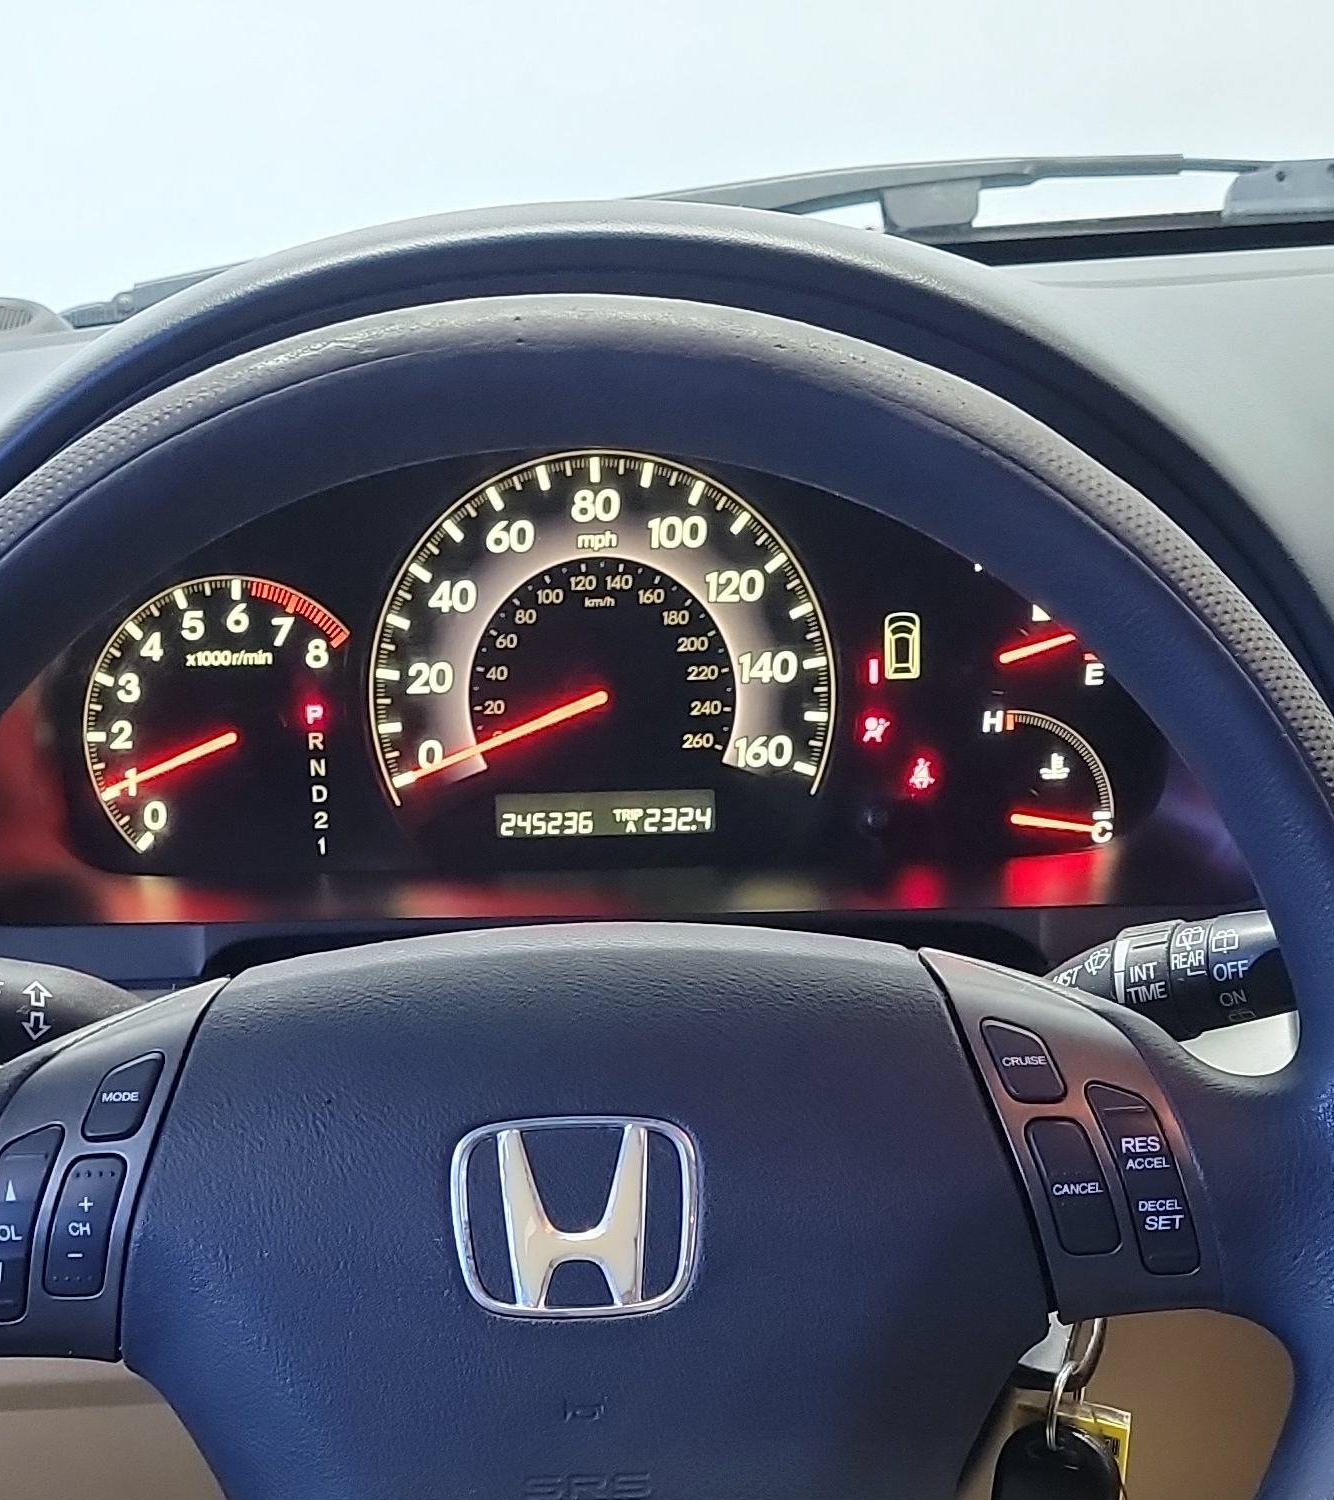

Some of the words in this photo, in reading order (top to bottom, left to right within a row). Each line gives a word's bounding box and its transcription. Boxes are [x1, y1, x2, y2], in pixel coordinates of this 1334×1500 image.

[570, 488, 621, 523] 80
[485, 519, 535, 554] 60
[577, 531, 617, 550] mph
[647, 515, 708, 549] 100
[570, 575, 596, 591] 120
[605, 574, 633, 590] 140
[704, 568, 765, 602] 120
[427, 579, 478, 613] 40
[536, 589, 564, 604] 100
[584, 597, 615, 607] km/h
[638, 589, 665, 605] 160
[180, 610, 205, 641] 5
[225, 602, 250, 633] 6
[514, 609, 536, 625] 80
[662, 610, 689, 626] 180
[271, 616, 295, 647] 7
[140, 631, 164, 662] 4
[495, 634, 518, 649] 60
[676, 637, 709, 652] 200
[305, 638, 329, 669] 8
[485, 666, 508, 681] 40
[687, 665, 719, 681] 220
[738, 650, 798, 684] 140
[1085, 662, 1105, 687] E
[116, 672, 142, 703] 3
[406, 661, 454, 695] 20
[306, 704, 325, 725] P
[483, 700, 506, 715] 20
[690, 700, 722, 716] 240
[982, 711, 1003, 732] H
[109, 720, 134, 750] 2
[308, 732, 325, 750] R
[682, 733, 714, 749] 260
[418, 739, 444, 770] 0
[733, 734, 793, 769] 160
[309, 758, 327, 777] N
[312, 784, 329, 803] D
[143, 800, 167, 831] 0
[313, 811, 329, 830] 2
[501, 811, 594, 837] 245236
[643, 807, 713, 833] 232.4
[612, 808, 644, 822] TRIP
[625, 820, 637, 833] A
[1091, 814, 1114, 842] C
[317, 837, 327, 856] 1
[1171, 950, 1206, 970] REAR
[1129, 962, 1158, 984] INT
[1212, 961, 1252, 982] OFF
[1126, 982, 1167, 1004] TIME
[1219, 989, 1248, 1007] ON
[1001, 1055, 1047, 1067] CRUISE
[101, 1091, 140, 1103] MODE
[1121, 1136, 1161, 1154] RES
[1125, 1157, 1170, 1170] ACCEL
[1052, 1182, 1104, 1196] CANCEL
[1138, 1200, 1183, 1211] DECEL
[68, 1222, 92, 1236] CH
[1144, 1215, 1185, 1230] SET
